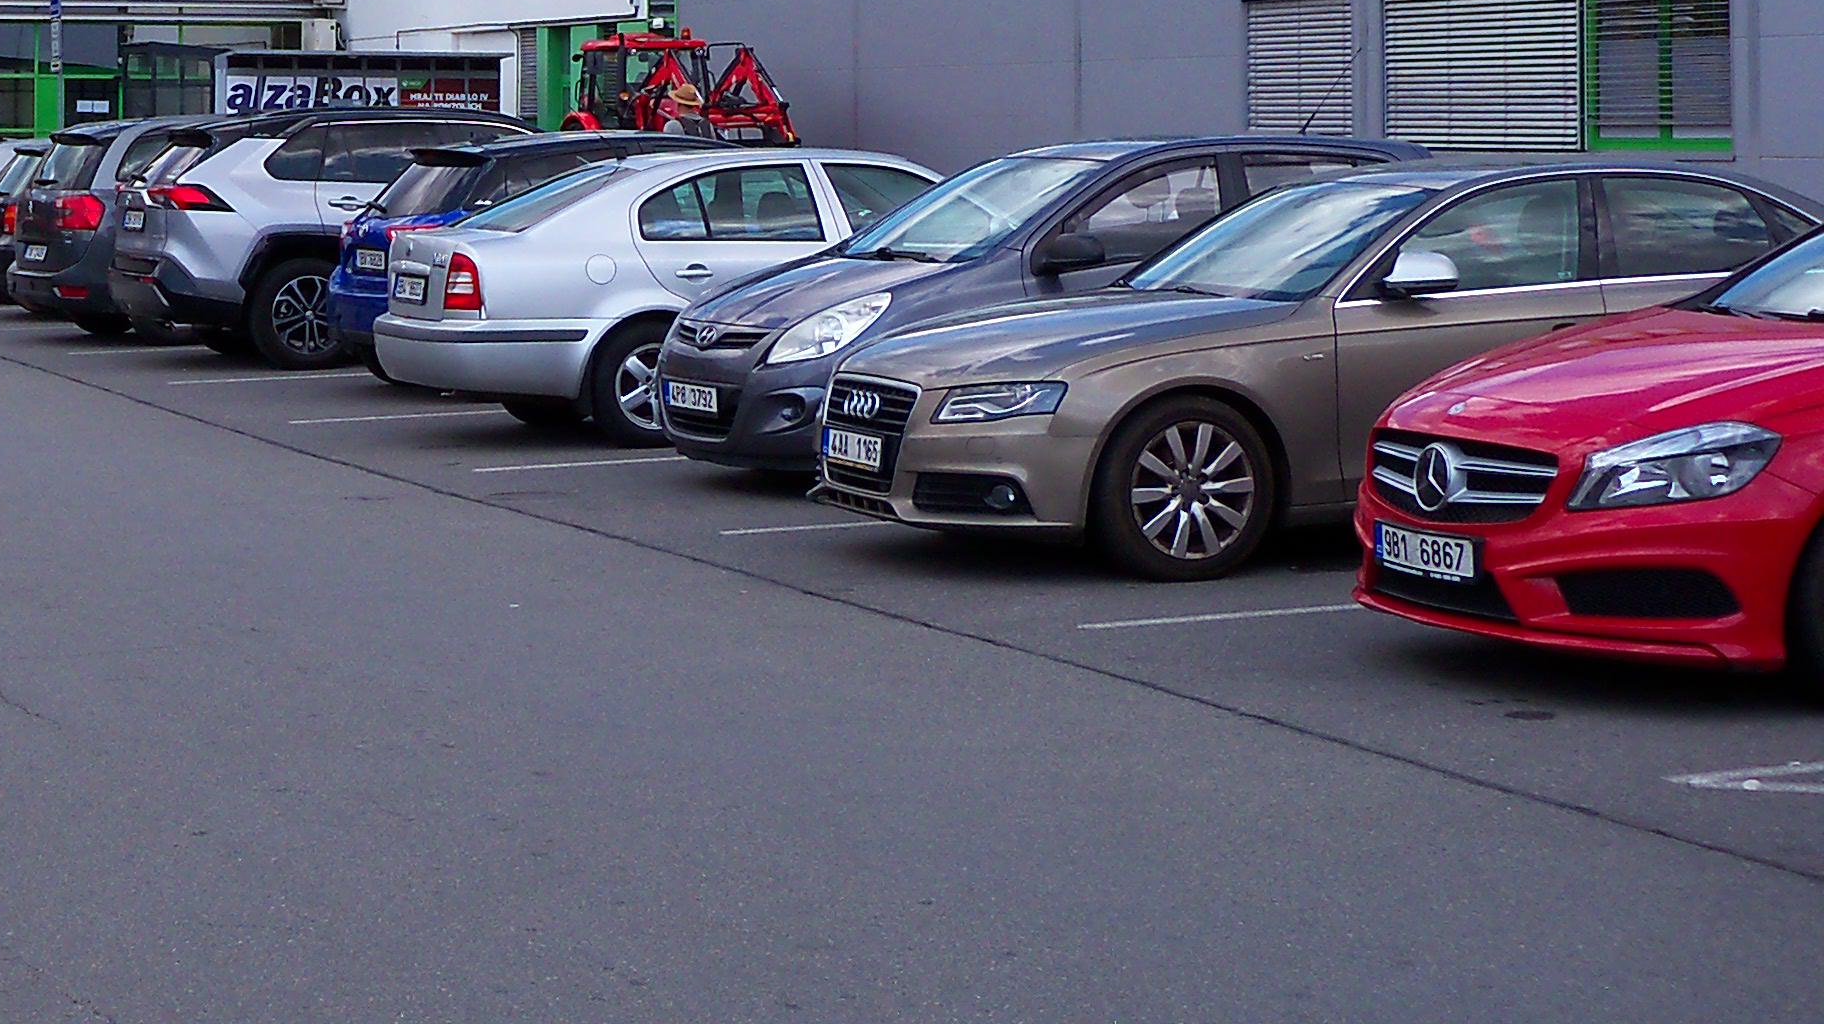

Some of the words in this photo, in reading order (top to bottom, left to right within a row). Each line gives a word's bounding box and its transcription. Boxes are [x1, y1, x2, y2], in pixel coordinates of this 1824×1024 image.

[227, 76, 396, 111] alzaBox
[1384, 528, 1409, 562] 9B1
[1419, 537, 1465, 572] 6867
